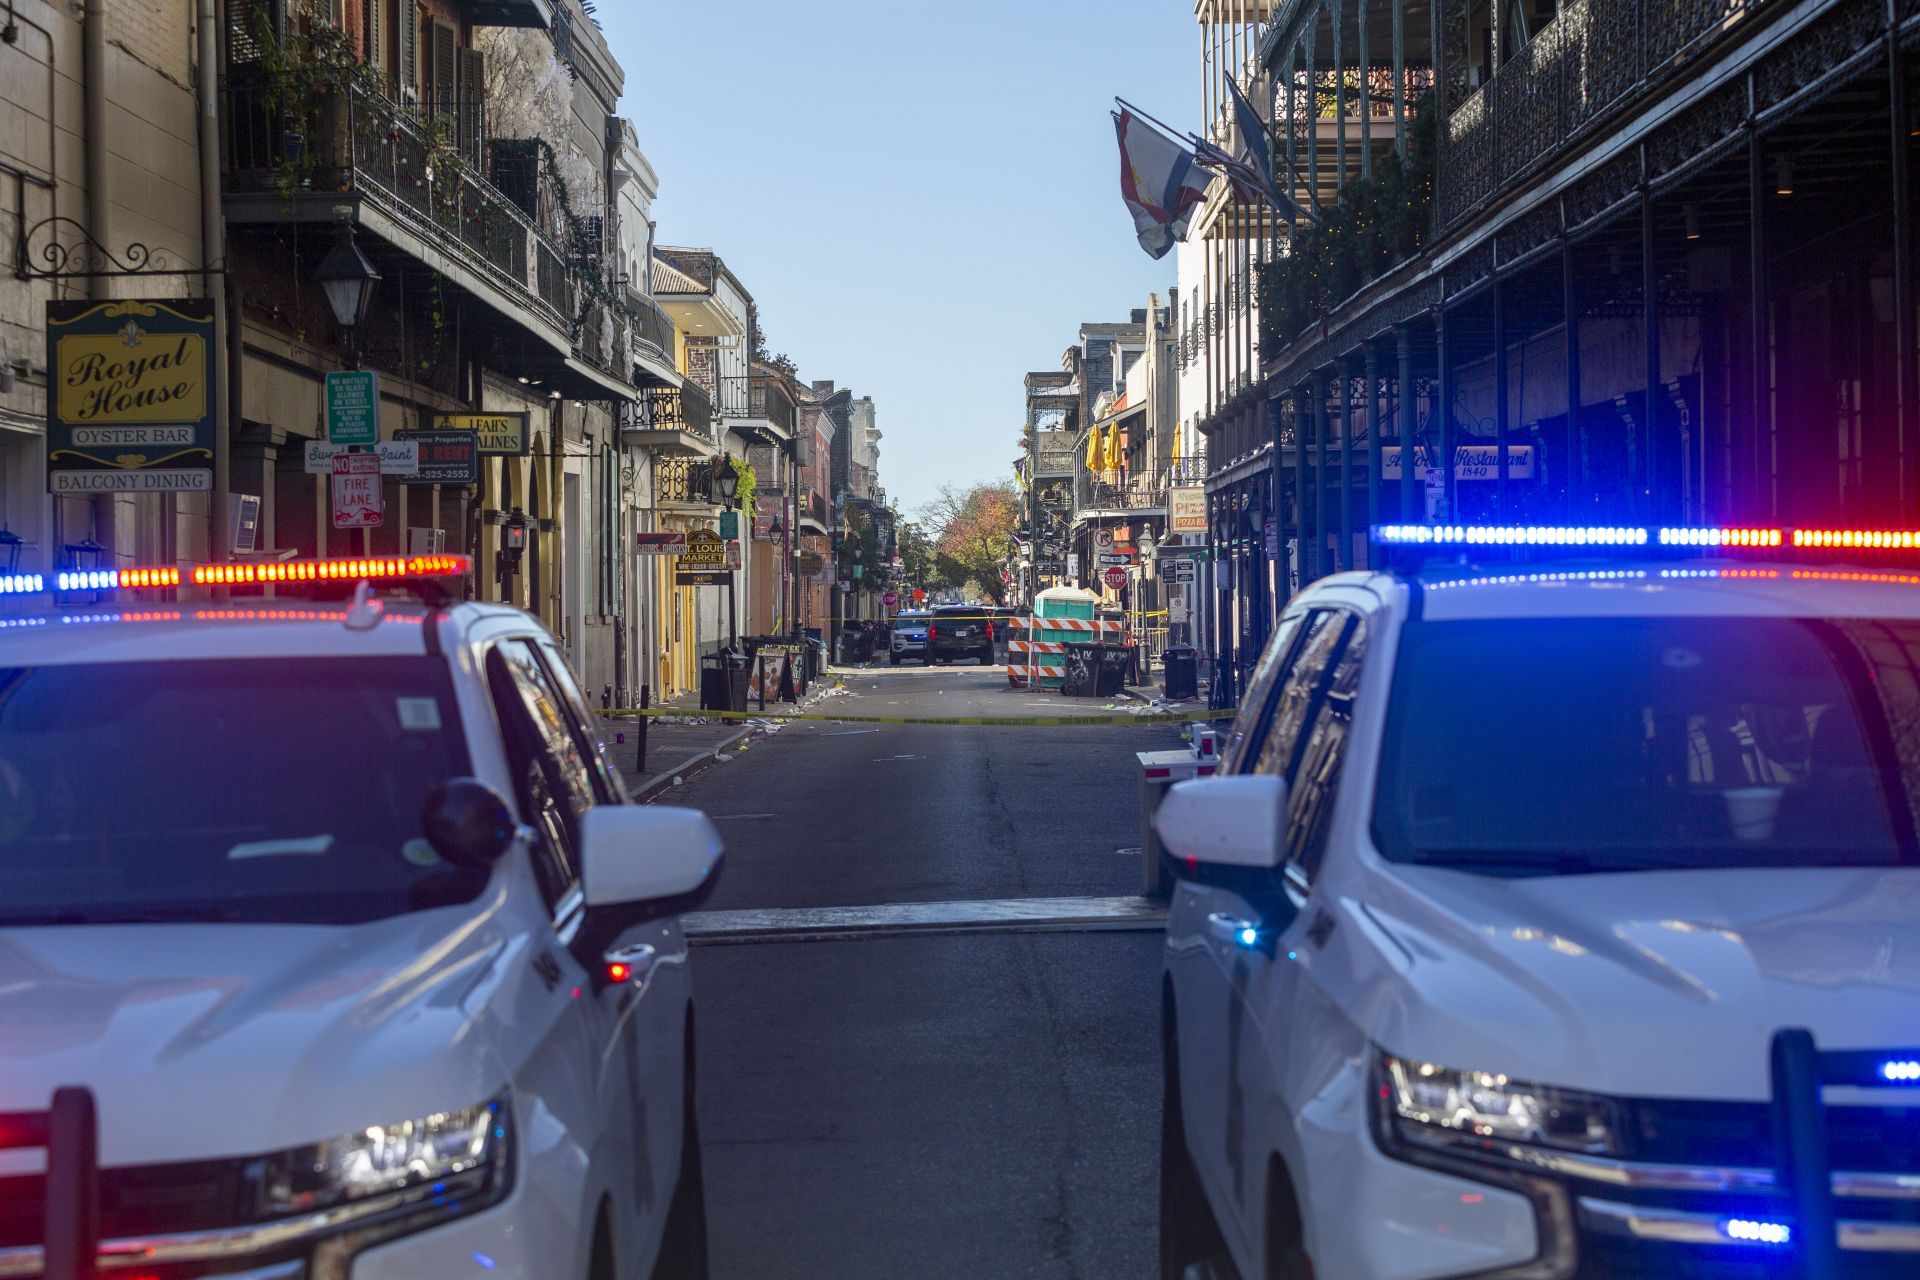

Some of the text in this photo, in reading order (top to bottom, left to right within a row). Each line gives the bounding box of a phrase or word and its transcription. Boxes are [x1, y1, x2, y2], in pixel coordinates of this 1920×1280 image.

[67, 337, 193, 389] Royal
[342, 377, 368, 385] BOTTLES
[78, 381, 196, 419] House
[76, 429, 189, 443] OYSTER BAR
[478, 435, 518, 449] ALINES
[380, 446, 412, 460] Saint
[433, 445, 471, 461] RENT
[1455, 449, 1529, 466] Restauant
[334, 458, 349, 473] NO
[1462, 466, 1487, 477] 1840
[58, 474, 203, 490] BALCONY DINING
[344, 478, 369, 490] FIRE
[343, 494, 372, 506] LANE
[1175, 502, 1205, 514] PIZZ
[1177, 518, 1196, 526] PIZZA
[682, 554, 723, 562] MARKET
[1105, 573, 1126, 583] STOP
